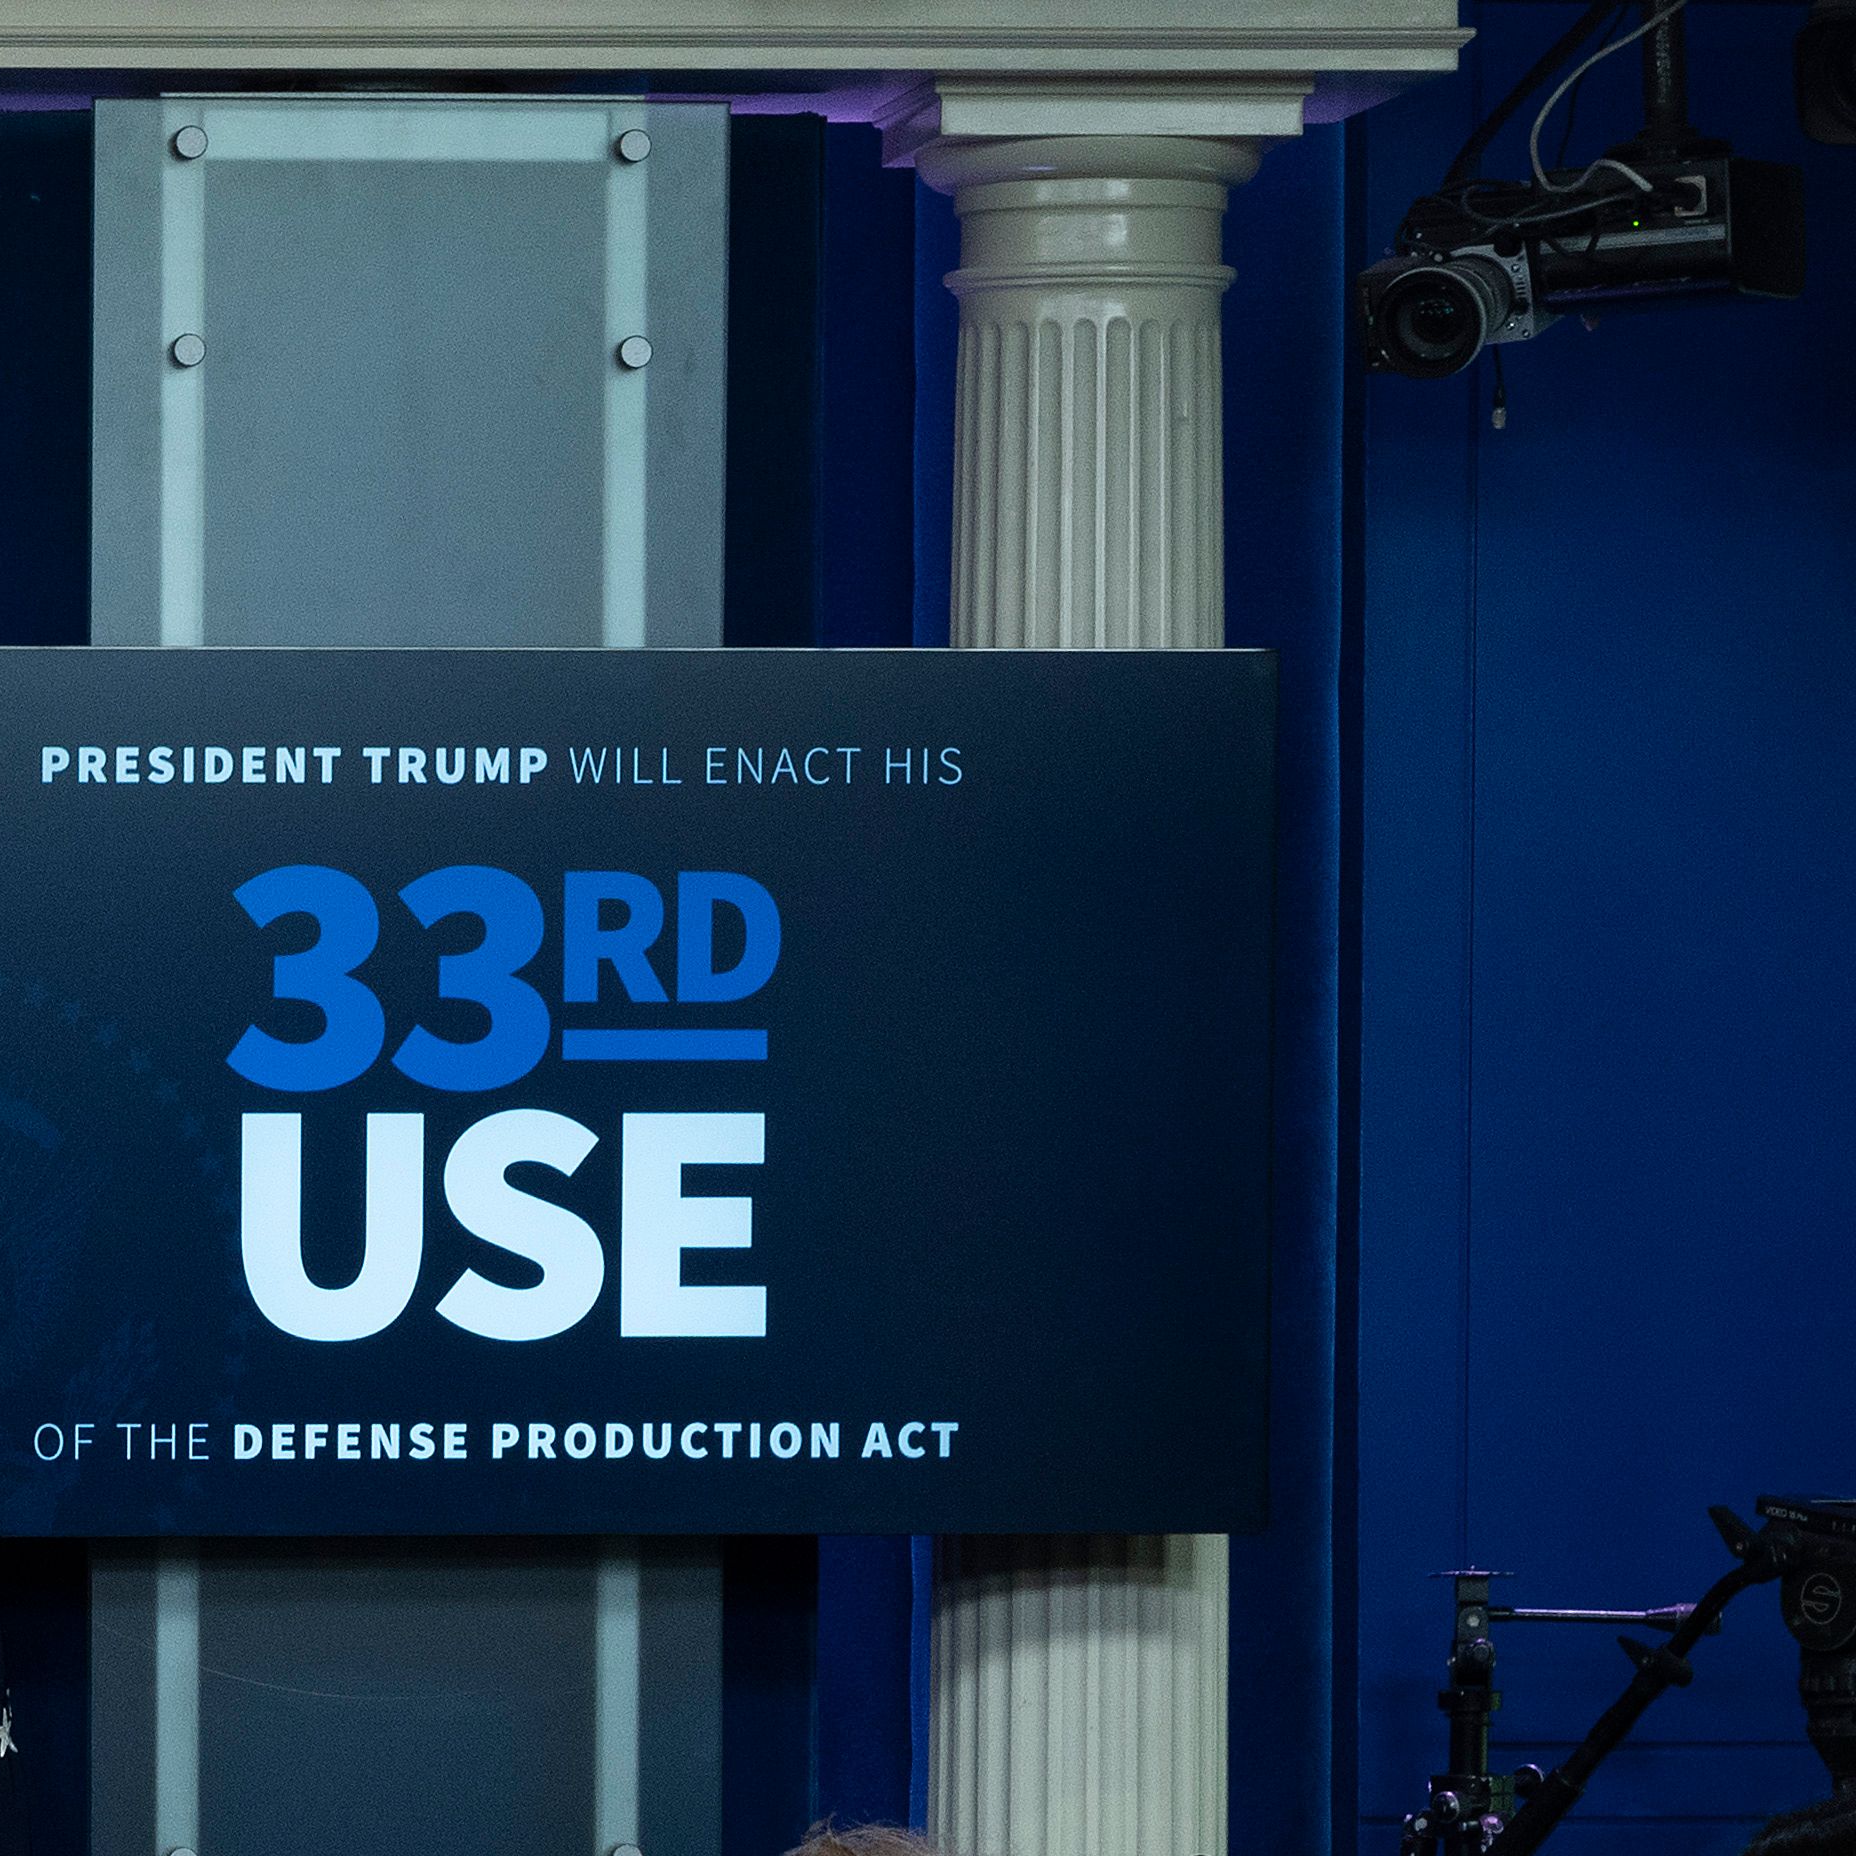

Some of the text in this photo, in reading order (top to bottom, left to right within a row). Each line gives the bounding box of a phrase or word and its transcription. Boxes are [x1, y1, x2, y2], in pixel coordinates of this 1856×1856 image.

[42, 747, 963, 786] PRESIDENT TRUMP WILL ENACT HIS
[225, 864, 783, 1094] 33RD
[241, 1109, 768, 1344] USE
[34, 1422, 960, 1462] OF THE DEFENSE PRODUCTION ACT
